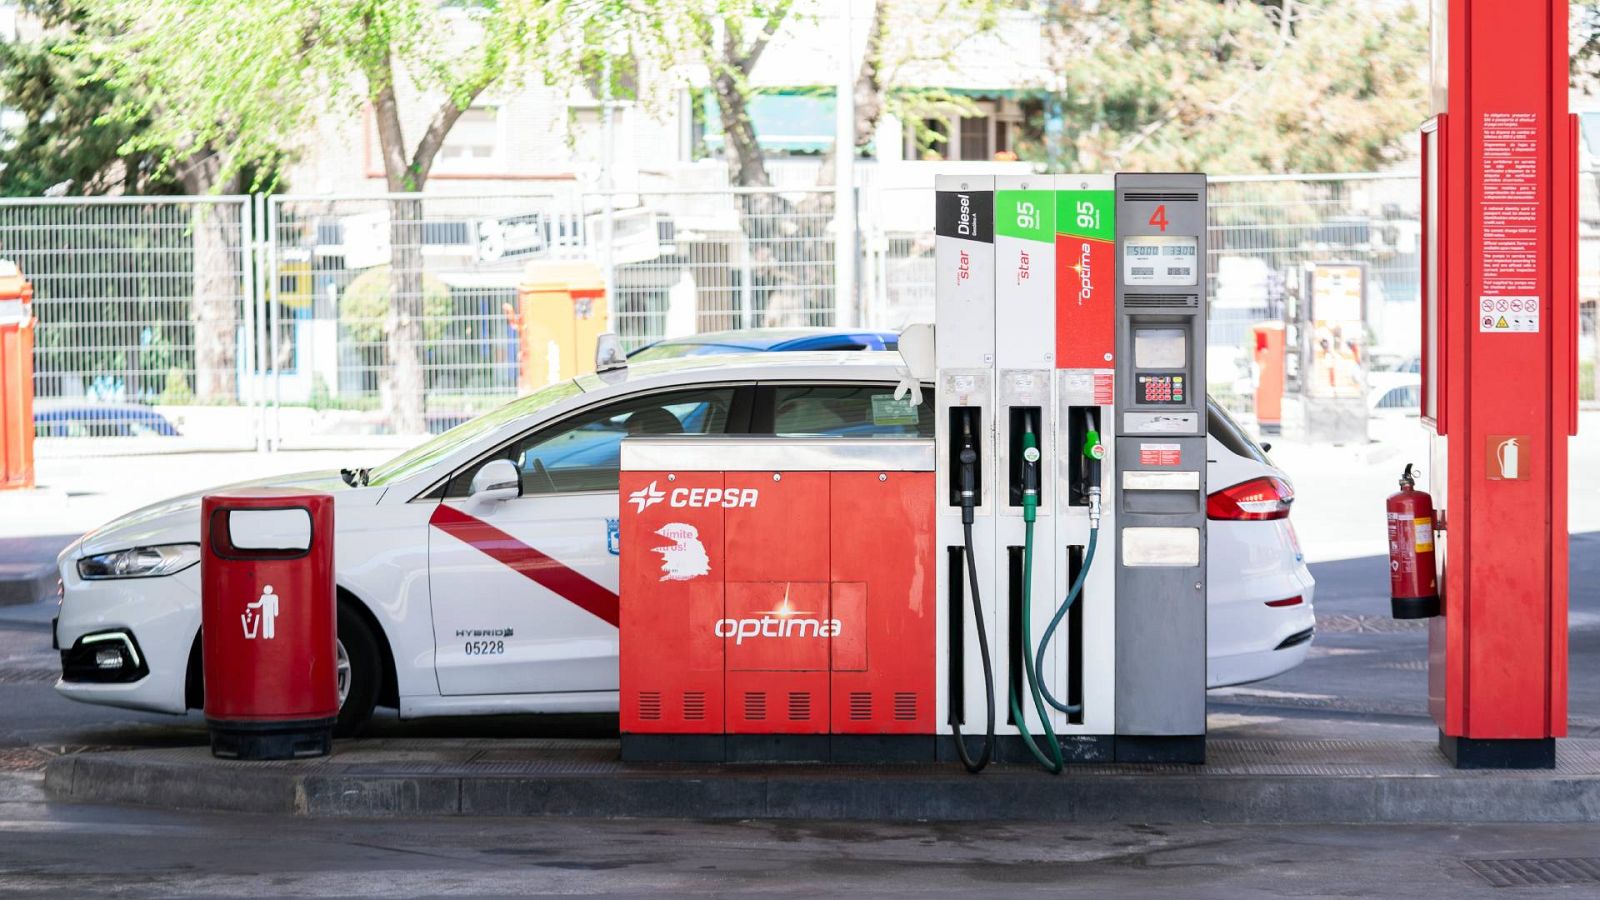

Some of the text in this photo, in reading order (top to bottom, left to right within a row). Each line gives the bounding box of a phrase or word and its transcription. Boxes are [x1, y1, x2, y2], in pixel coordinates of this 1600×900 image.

[958, 194, 970, 235] Diesel
[1016, 202, 1034, 228] 95
[1077, 202, 1094, 228] 95
[1148, 204, 1169, 232] 4
[960, 250, 970, 279] star
[1018, 250, 1029, 279] star
[1081, 243, 1094, 299] optima
[670, 488, 759, 508] CEPSA
[714, 614, 841, 645] optima
[465, 641, 504, 655] 05228
